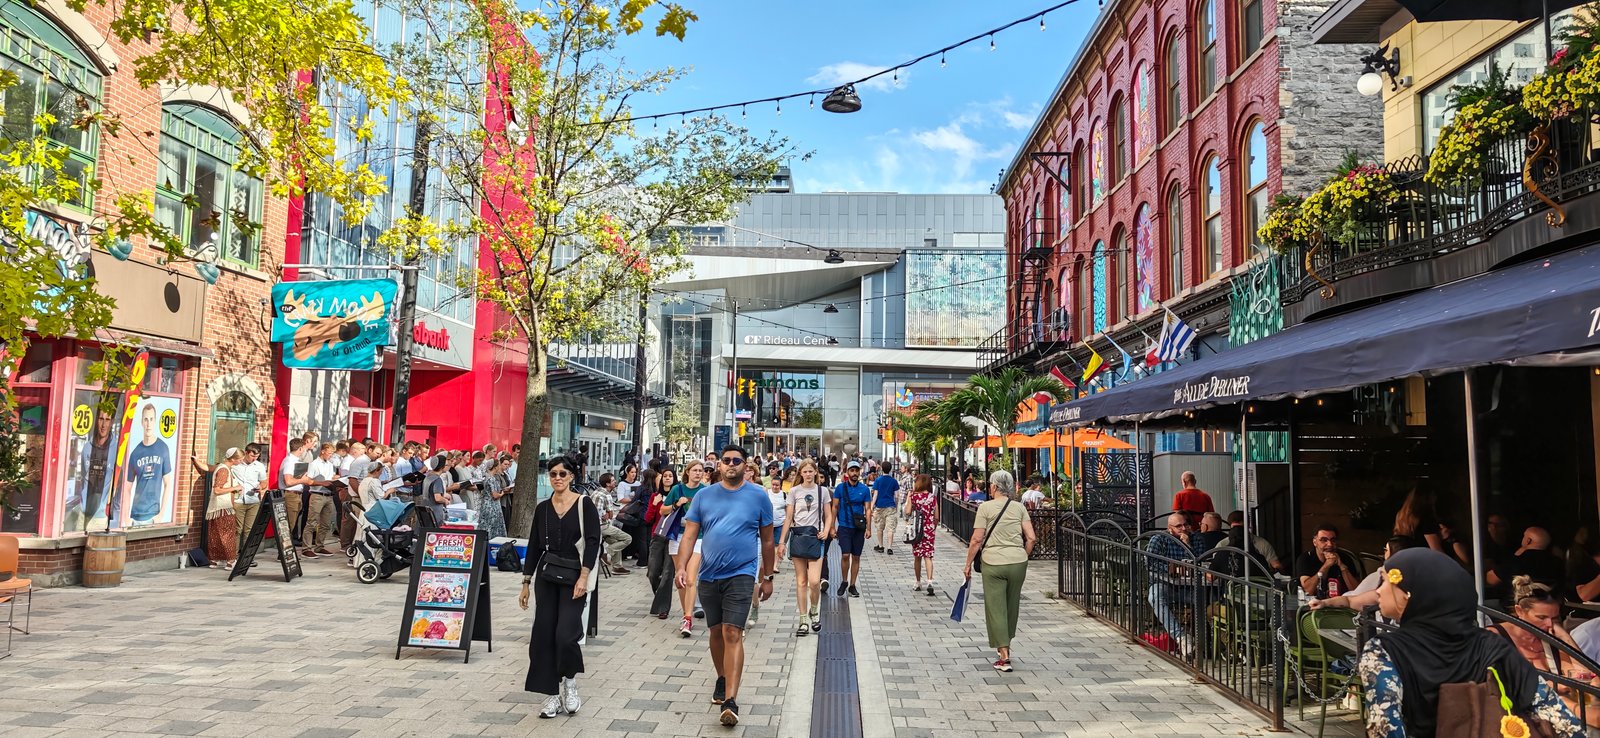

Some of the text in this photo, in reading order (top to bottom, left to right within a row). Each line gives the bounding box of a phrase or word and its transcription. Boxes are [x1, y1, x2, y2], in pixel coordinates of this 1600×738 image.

[414, 321, 450, 351] abank
[744, 335, 839, 346] CF Rideau Cent
[74, 410, 90, 429] $25
[137, 456, 161, 467] OTTAWA
